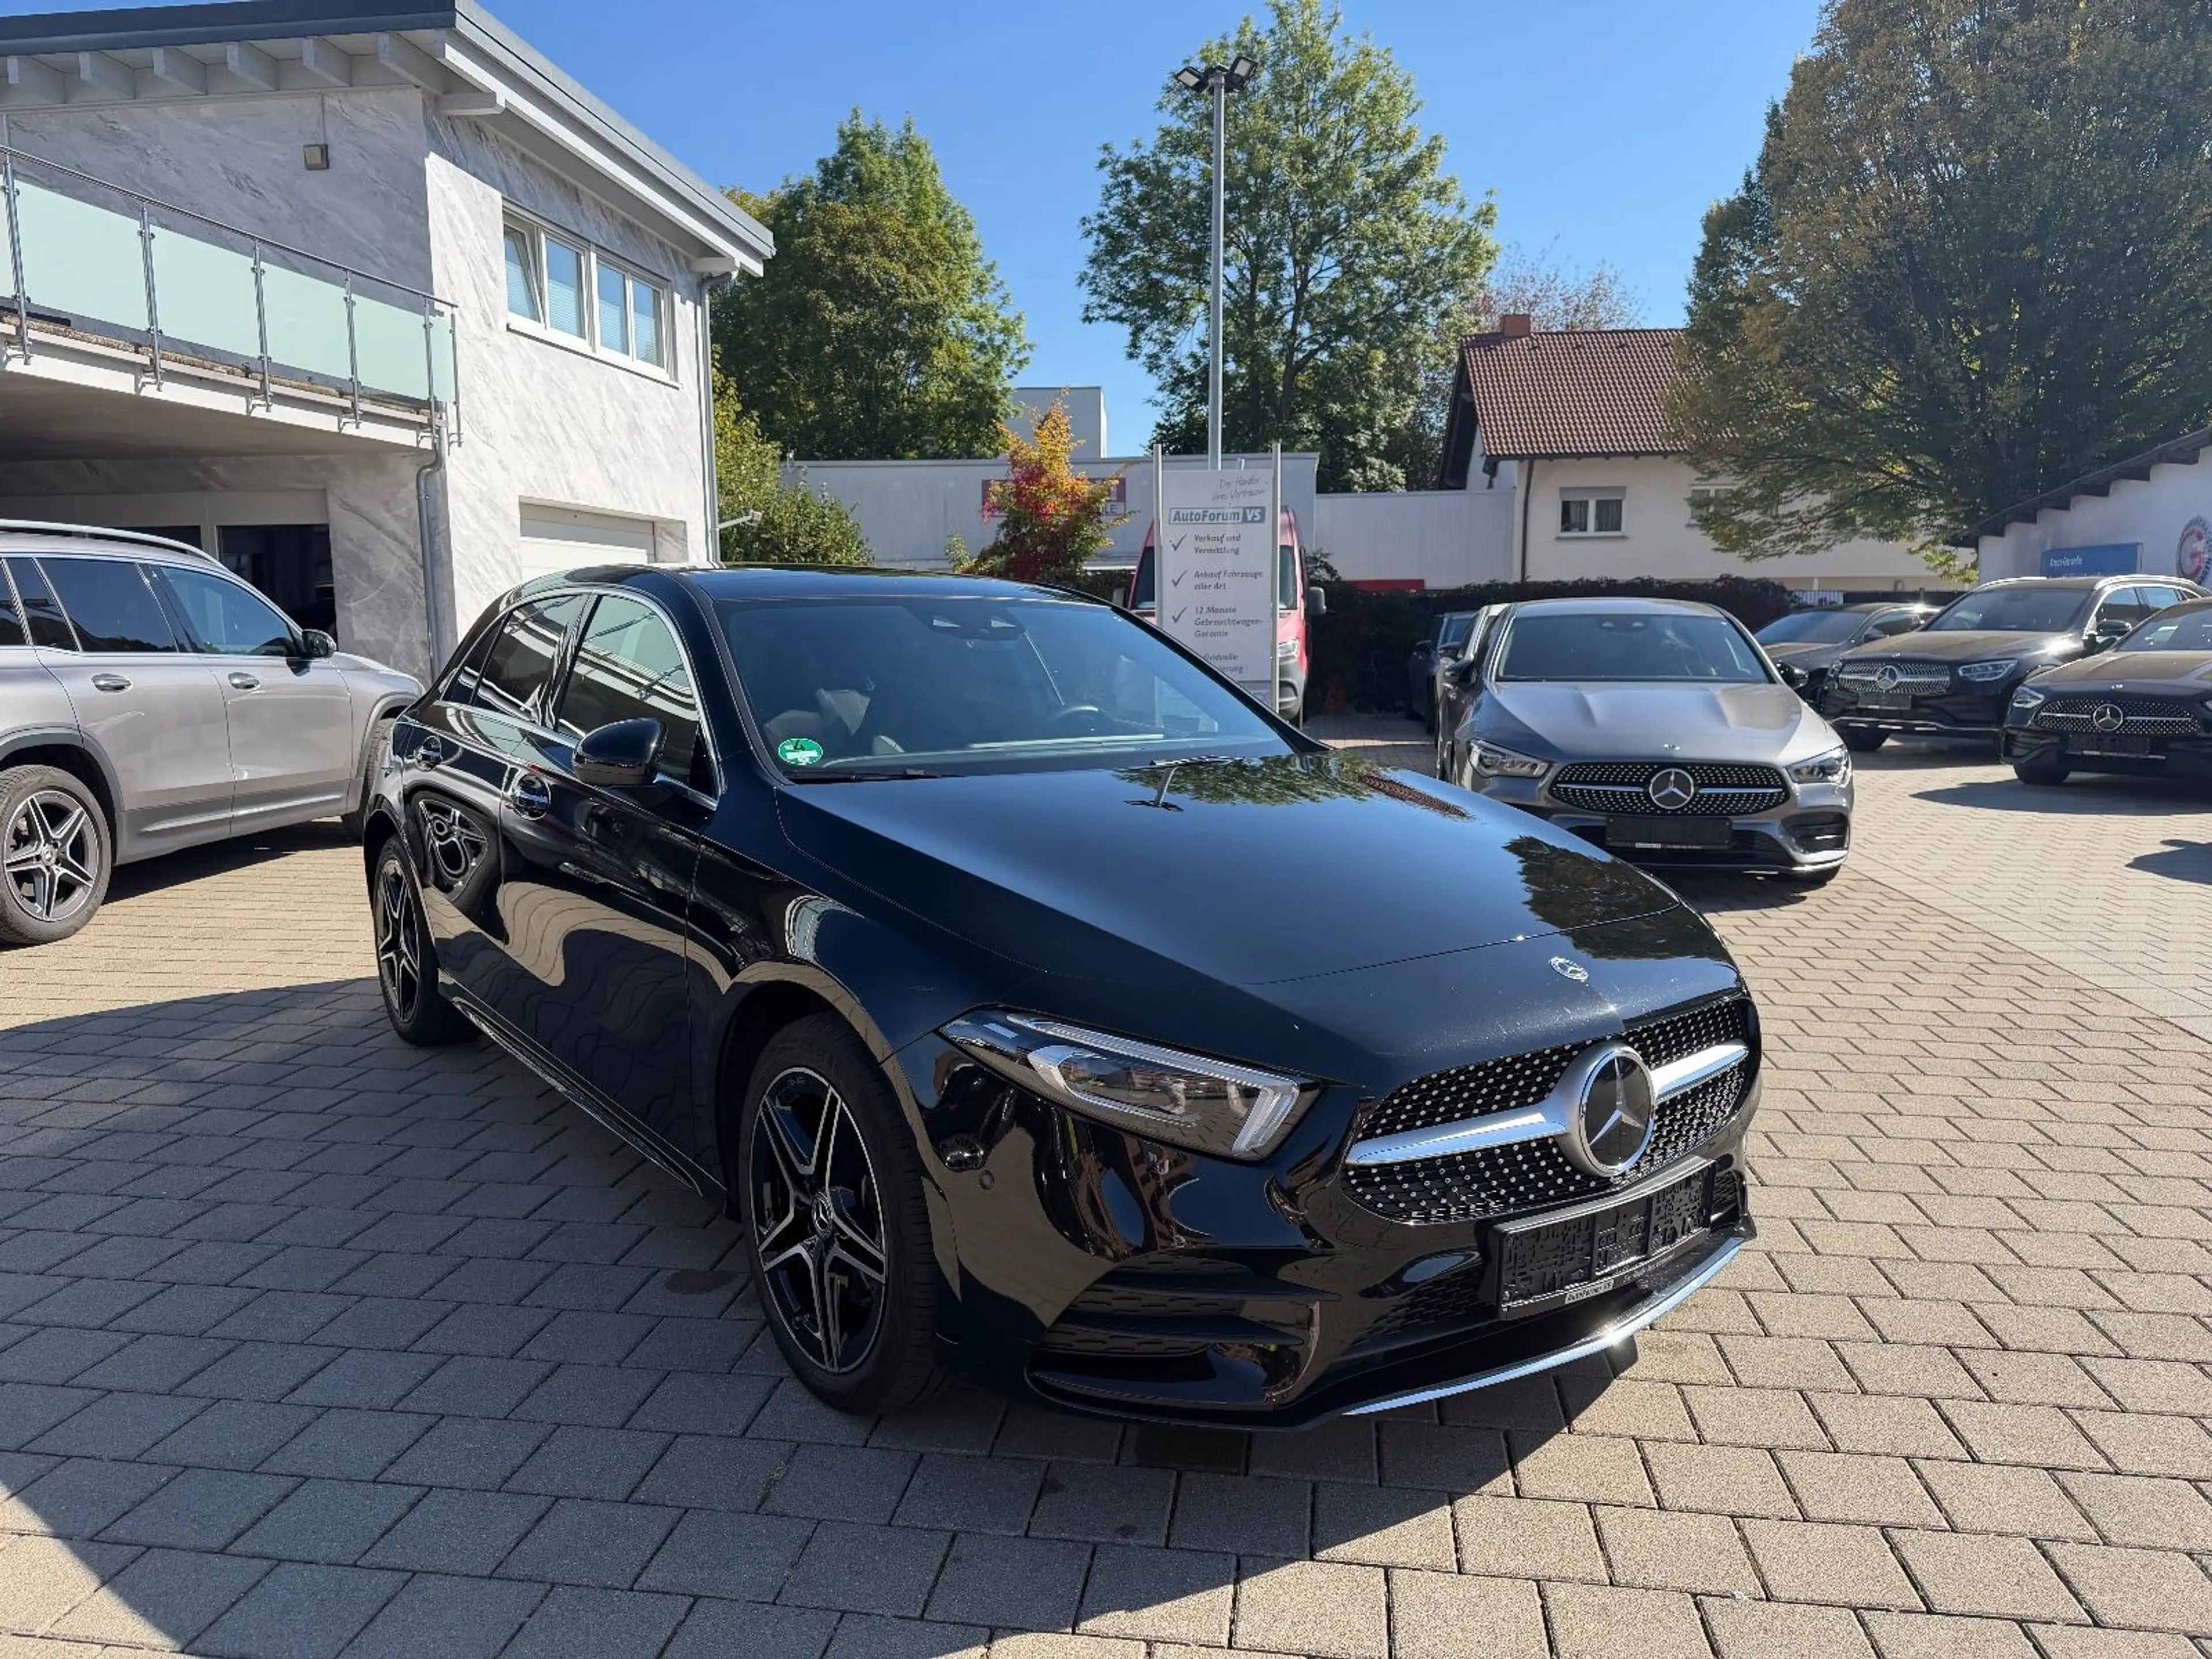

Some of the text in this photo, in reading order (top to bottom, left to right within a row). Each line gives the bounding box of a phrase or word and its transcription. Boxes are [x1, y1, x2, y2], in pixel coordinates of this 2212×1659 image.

[1172, 509, 1262, 522] AutoForum VS
[1194, 533, 1241, 544] Verkauf und
[1194, 546, 1240, 555] Vermittlung
[1194, 570, 1222, 579] Ankauf
[1205, 606, 1237, 614] Monate
[1194, 630, 1229, 638] Garantie
